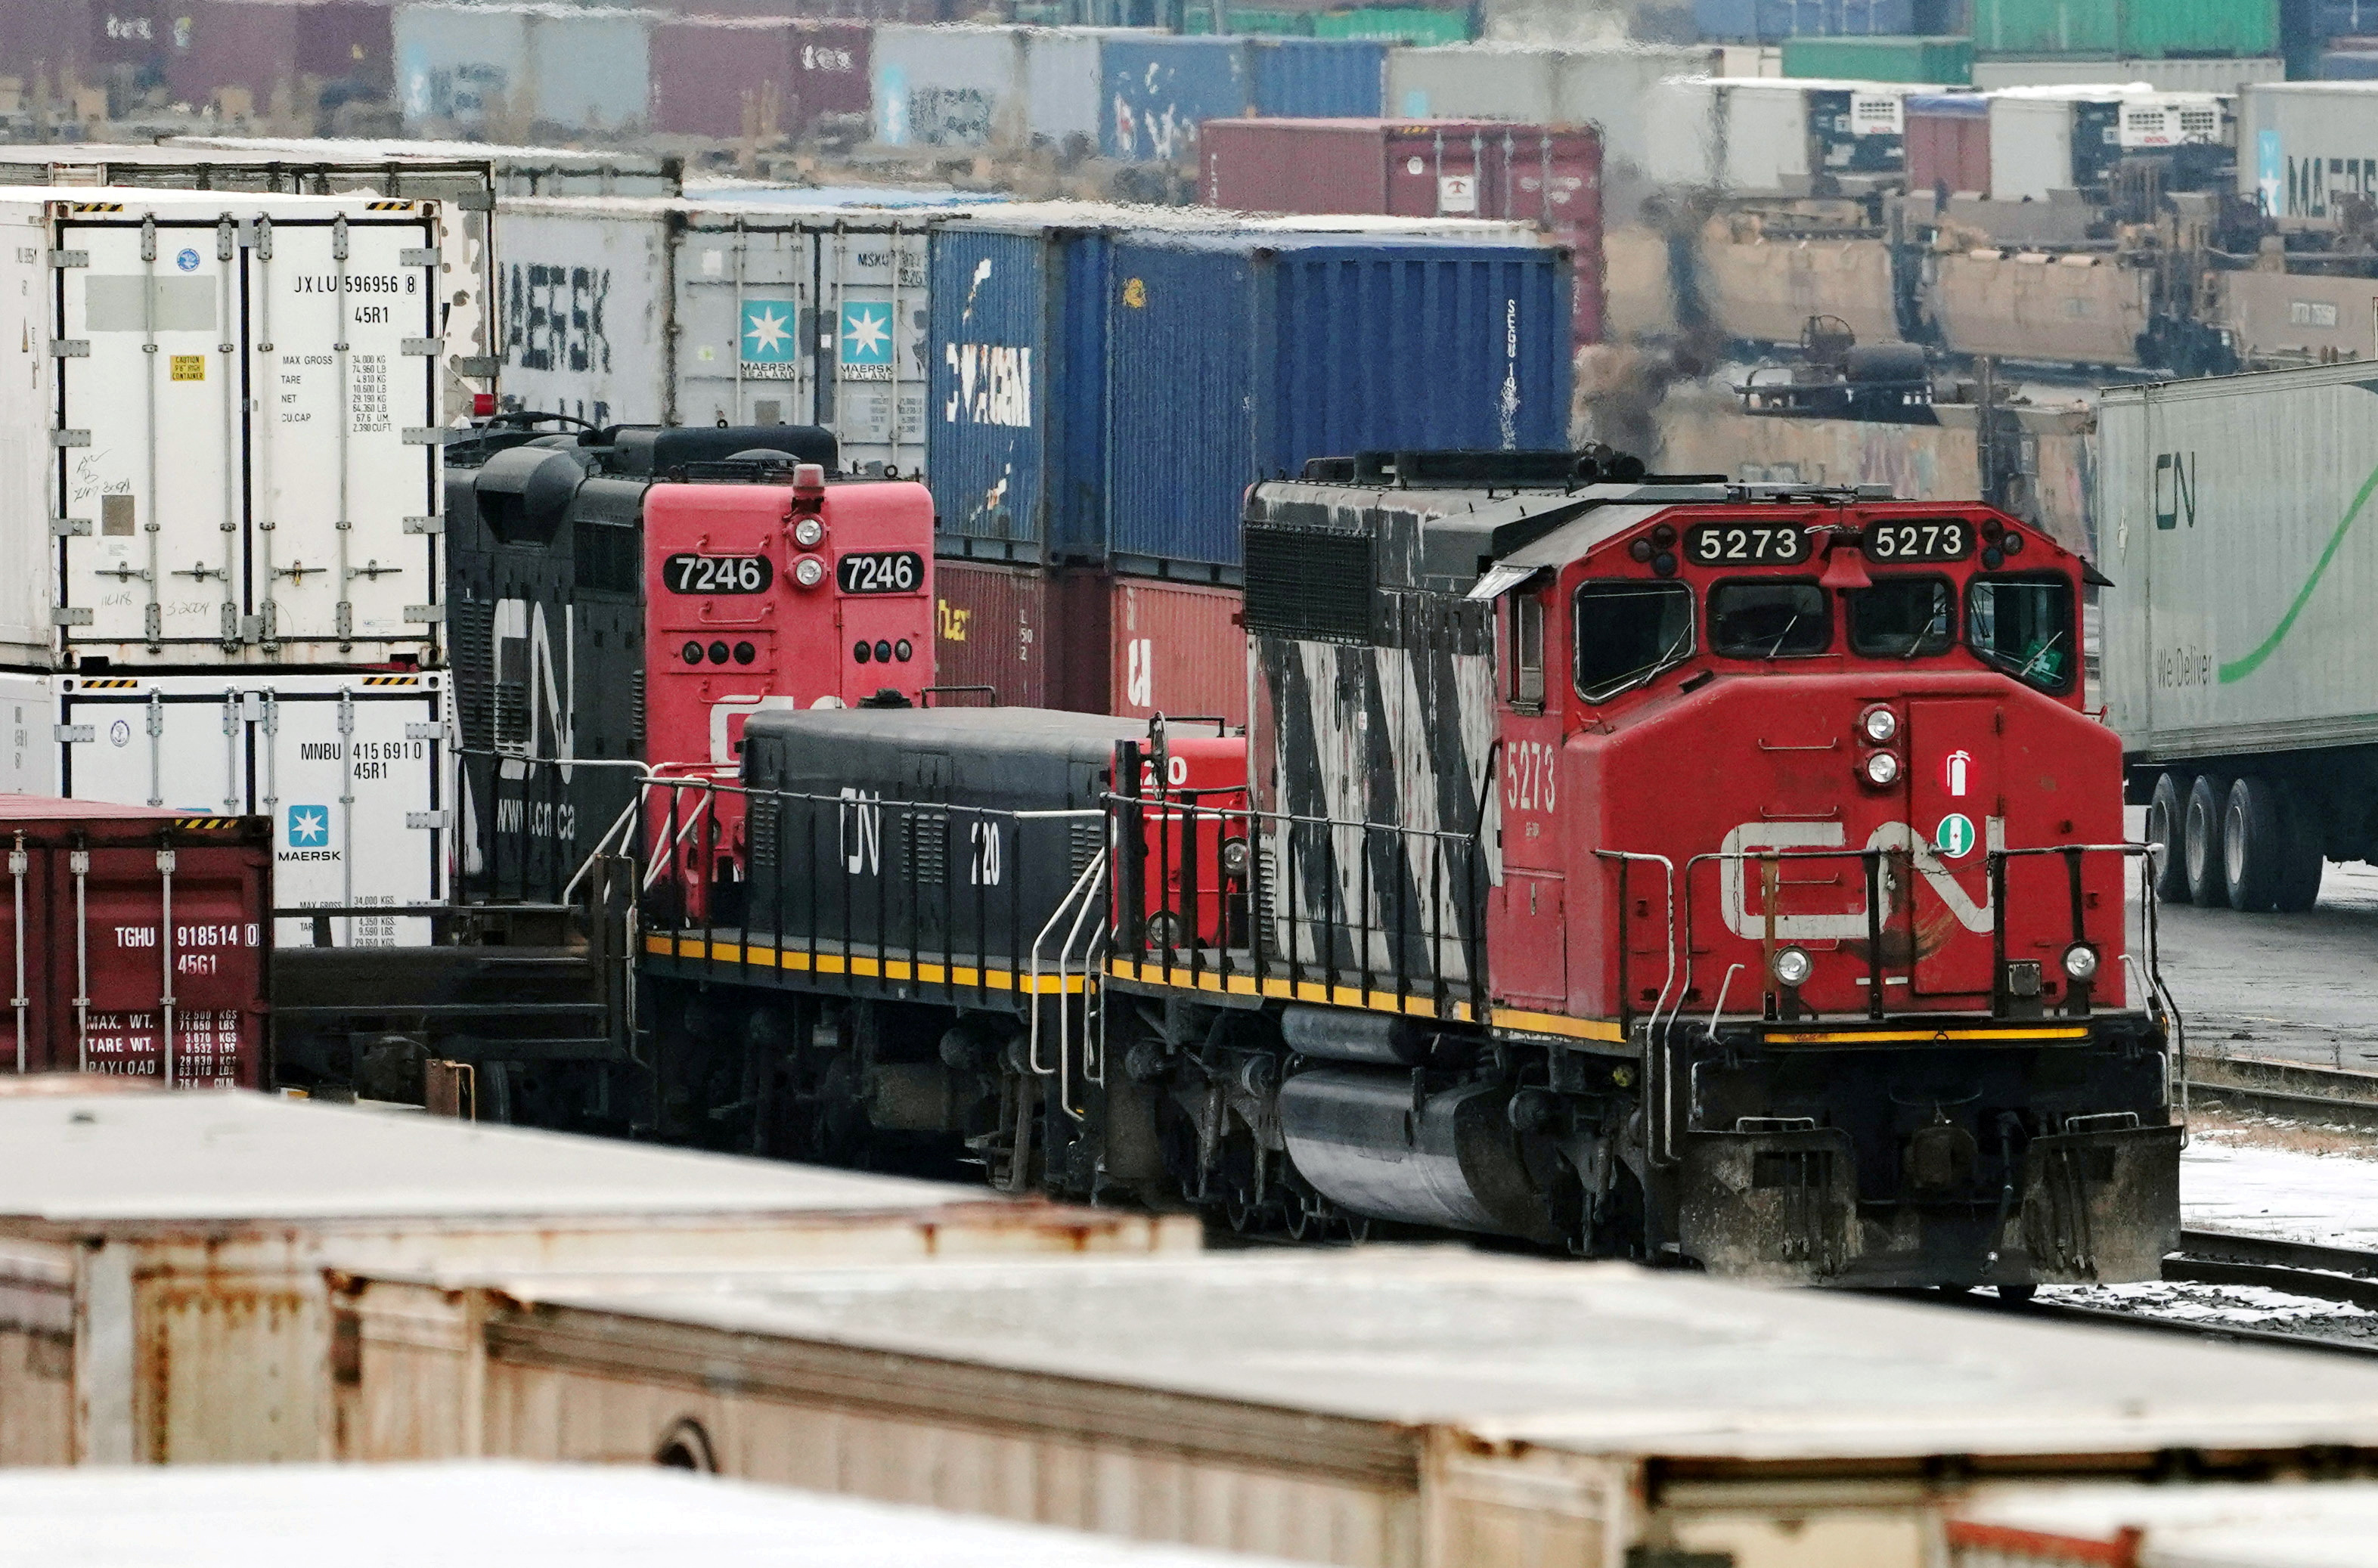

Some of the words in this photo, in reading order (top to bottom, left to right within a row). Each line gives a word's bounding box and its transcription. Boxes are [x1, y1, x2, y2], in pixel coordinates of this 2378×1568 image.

[294, 276, 337, 293] JXLU
[345, 275, 398, 293] 596956
[407, 276, 415, 293] 8
[355, 306, 389, 324] 45R1
[283, 356, 301, 365] MAX
[304, 355, 333, 365] GROSS
[377, 355, 386, 364] KG
[377, 365, 387, 373] LB
[740, 362, 795, 372] MAERSK
[281, 375, 301, 384] TARE
[377, 375, 386, 383] KG
[377, 385, 387, 393] LB
[281, 395, 297, 403] NET
[377, 395, 386, 403] KG
[377, 404, 387, 413] LB
[2155, 451, 2195, 529] CN
[1700, 529, 1797, 559] 5273
[1875, 525, 1962, 558] 5273
[676, 557, 761, 590] 7246
[846, 556, 912, 590] 7246
[2157, 648, 2172, 689] We
[2177, 646, 2212, 687] Deliver
[493, 597, 574, 784] CN
[301, 743, 340, 761] MNBU
[353, 743, 378, 760] 415
[383, 743, 408, 759] 691
[414, 742, 422, 759] 0
[354, 763, 387, 779] 45R1
[1508, 739, 1555, 813] 5273
[278, 851, 340, 861] MAERSK
[1721, 815, 2005, 940] CN
[380, 897, 396, 905] KGS.
[380, 917, 396, 925] KGS.
[115, 927, 155, 947] TGHU
[177, 925, 237, 947] 918514
[381, 927, 395, 935] LBS.
[178, 955, 216, 975] 45G1
[219, 1010, 237, 1020] KGS
[86, 1015, 122, 1030] MAX.
[129, 1014, 153, 1029] WT.
[219, 1021, 235, 1030] LBS
[219, 1032, 237, 1043] KGS
[88, 1037, 123, 1052] TARE
[129, 1037, 155, 1052] WT.
[219, 1043, 235, 1053] LBS
[219, 1055, 237, 1066] KGS
[88, 1059, 155, 1075] PAYLOAD
[219, 1066, 235, 1076] LBS
